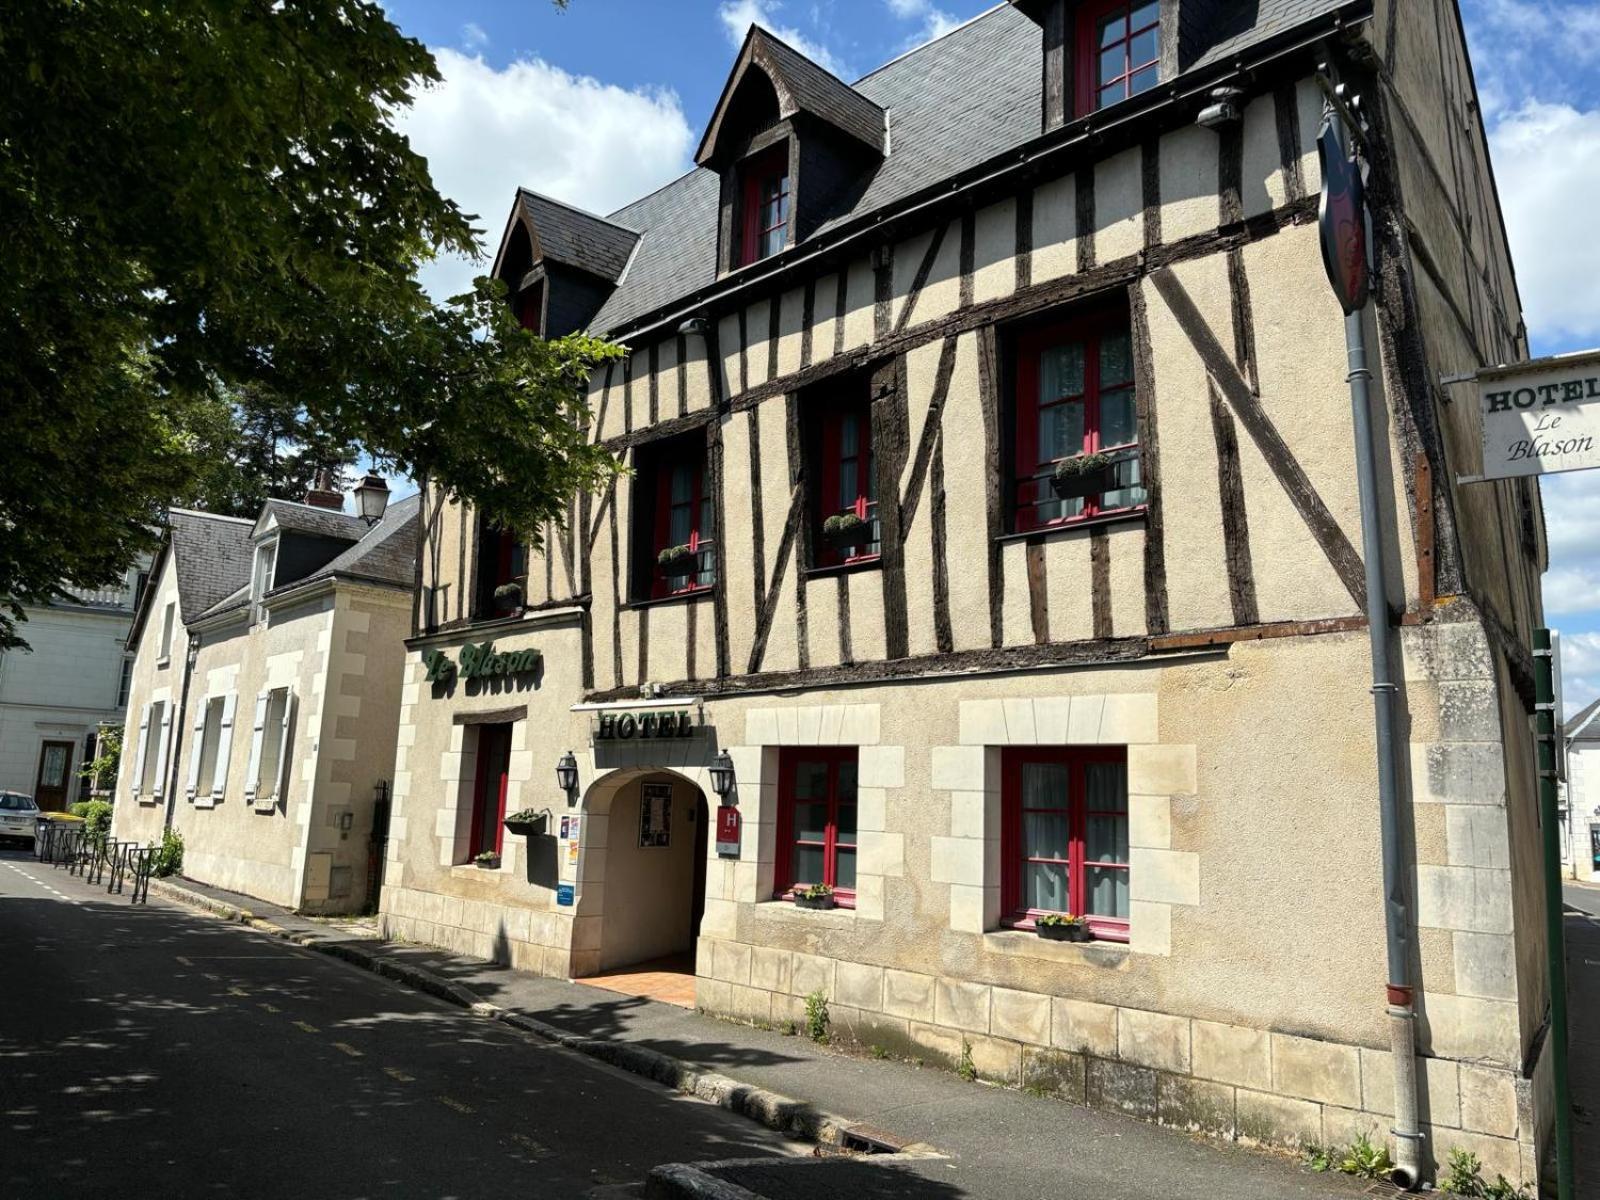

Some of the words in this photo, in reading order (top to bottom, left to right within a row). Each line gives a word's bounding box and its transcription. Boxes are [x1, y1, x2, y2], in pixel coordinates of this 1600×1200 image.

[1486, 378, 1600, 413] HOTEL
[1533, 414, 1562, 431] Le
[1506, 434, 1593, 461] Blason
[425, 649, 453, 681] Le
[459, 641, 541, 677] Blason
[597, 711, 692, 739] HOTEL
[726, 813, 737, 827] H
